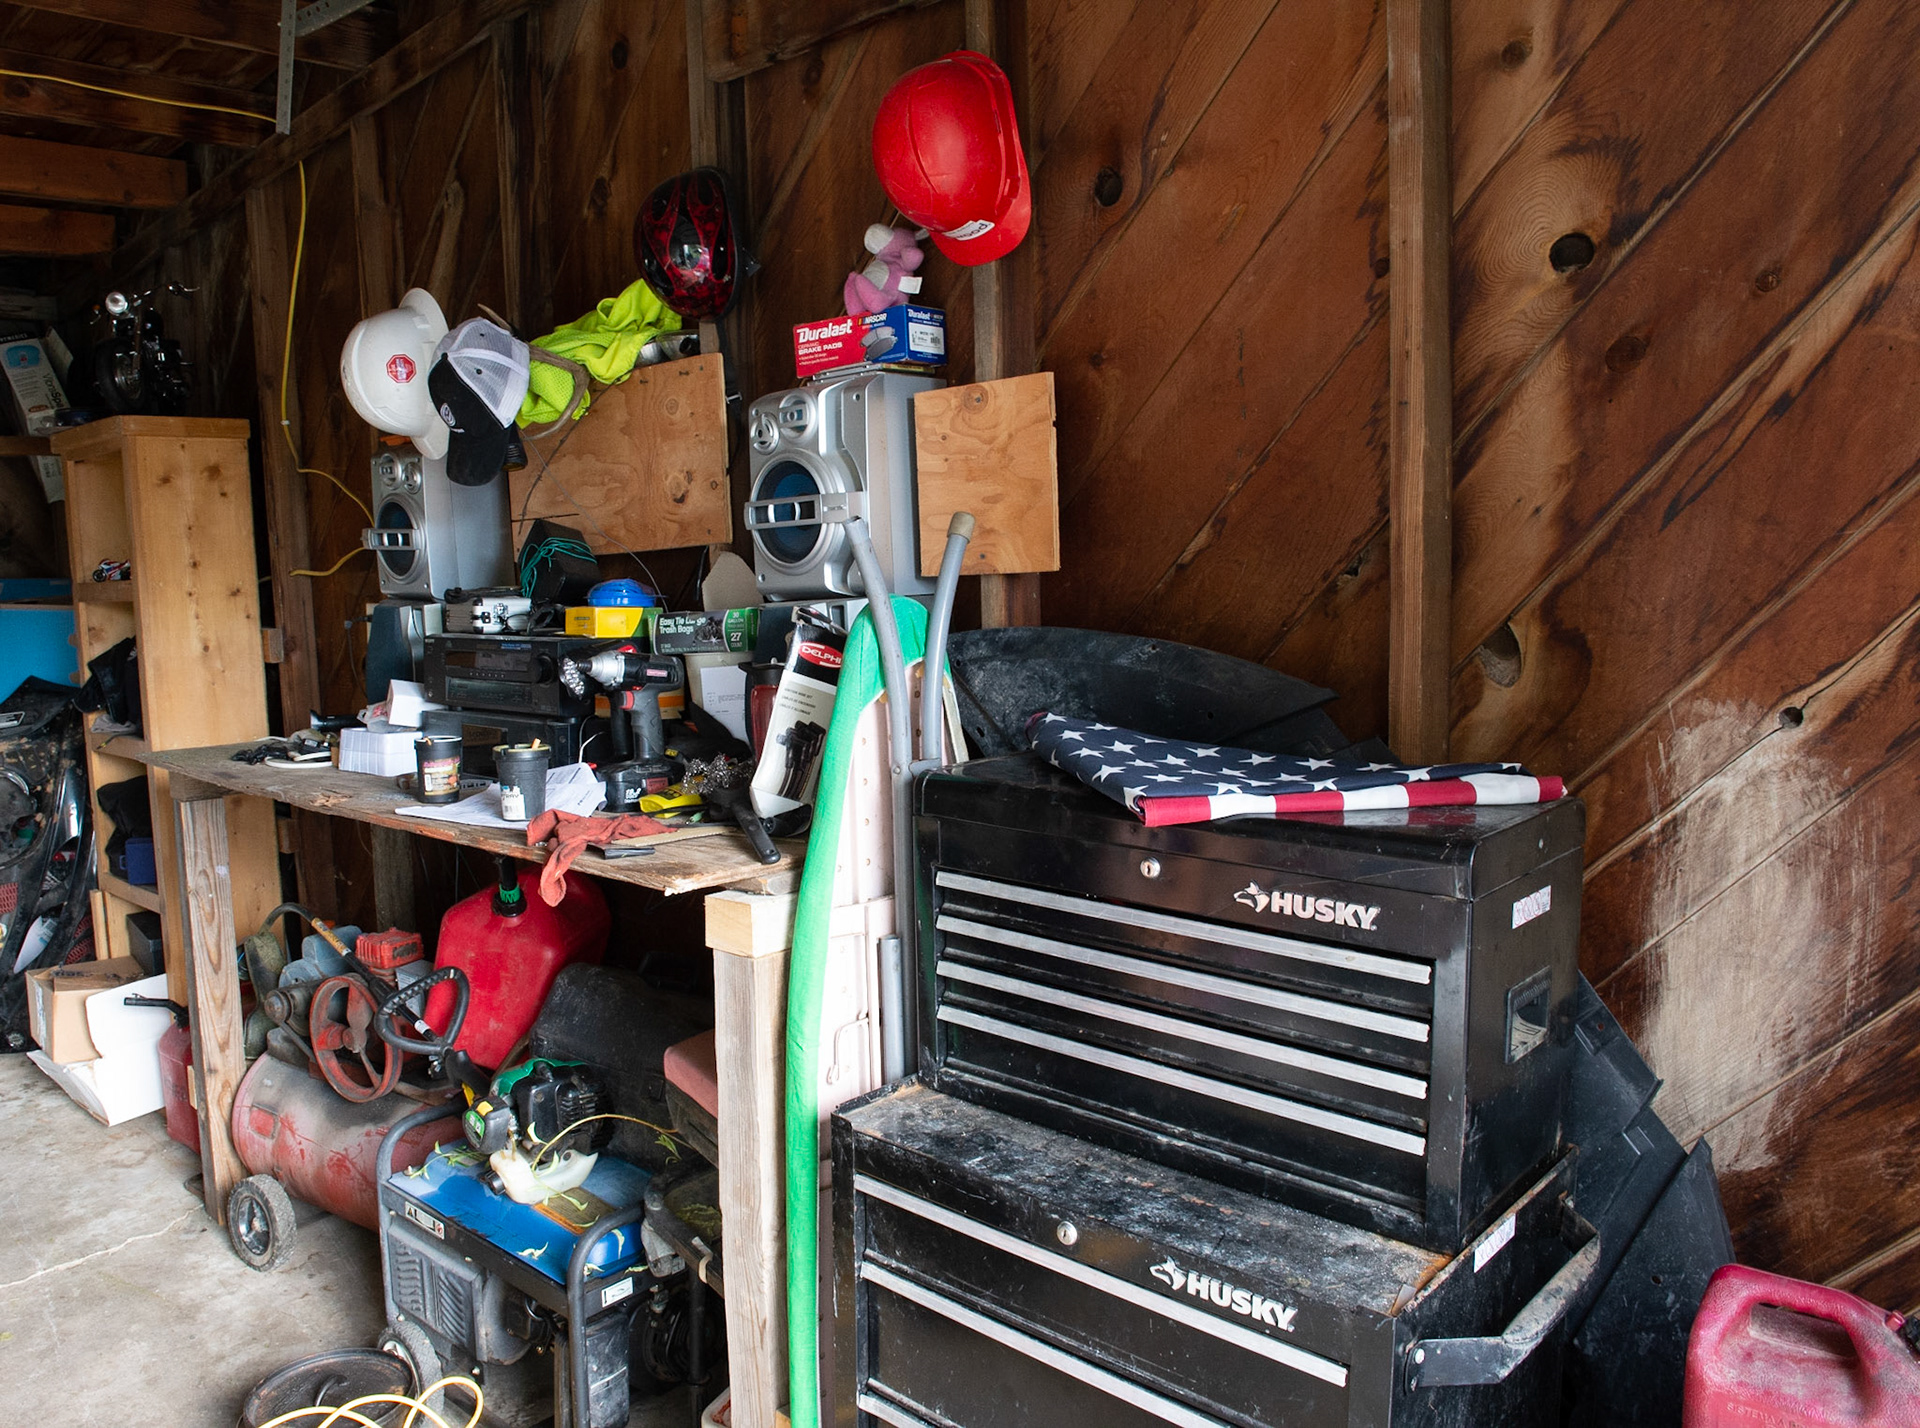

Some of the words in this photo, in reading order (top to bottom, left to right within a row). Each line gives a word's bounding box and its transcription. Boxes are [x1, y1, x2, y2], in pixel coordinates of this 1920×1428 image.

[864, 312, 888, 326] NASCAR
[796, 318, 853, 344] Duralast
[798, 345, 822, 356] BRAKE
[823, 341, 843, 350] PADS
[659, 617, 674, 627] Easy
[675, 616, 685, 625] Tie
[659, 625, 677, 634] Trash
[677, 624, 694, 635] Bags
[730, 632, 742, 642] 27
[801, 645, 842, 664] DELPHI
[1270, 890, 1381, 930] HUSKY
[1186, 1269, 1299, 1332] HUSKY
